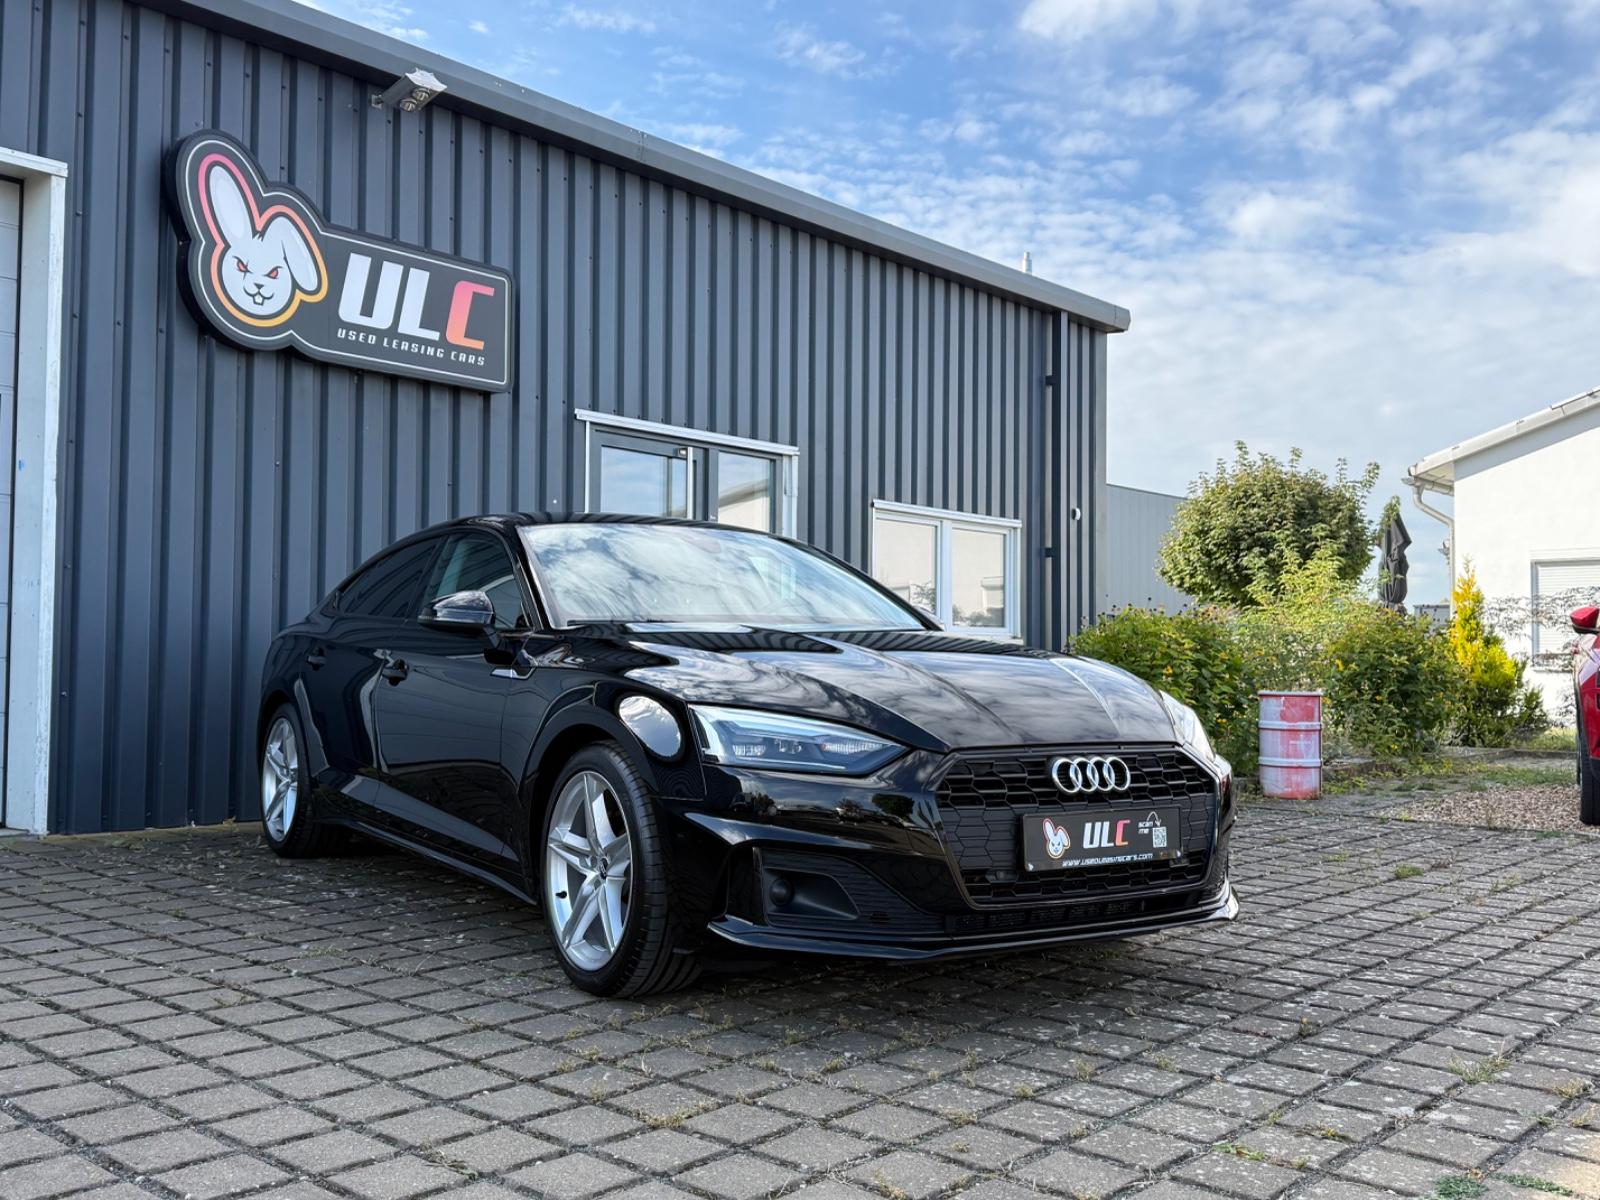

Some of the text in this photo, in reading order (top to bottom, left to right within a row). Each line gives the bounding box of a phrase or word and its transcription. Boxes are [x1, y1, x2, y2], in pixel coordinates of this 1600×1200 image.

[338, 252, 495, 350] ULC
[337, 328, 486, 366] USED LEASING CARS
[1082, 820, 1130, 849] ULC
